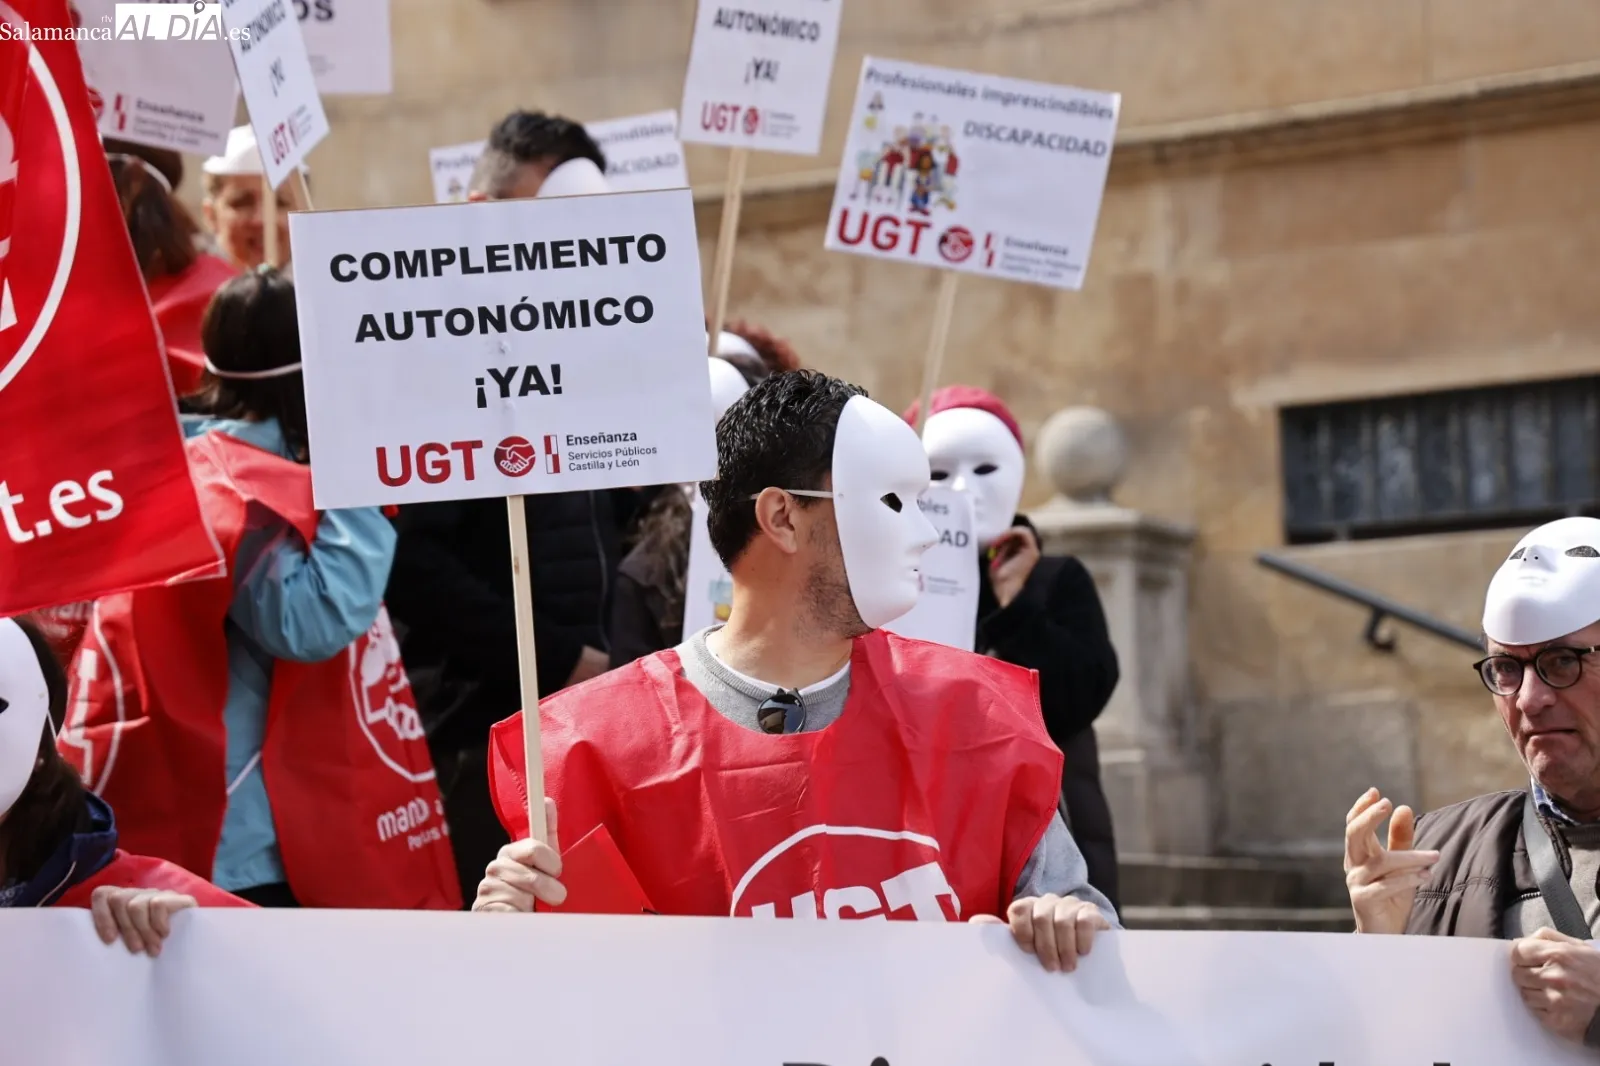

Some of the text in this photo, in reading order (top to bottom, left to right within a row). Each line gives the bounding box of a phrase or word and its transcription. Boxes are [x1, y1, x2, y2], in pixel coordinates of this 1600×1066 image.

[865, 67, 977, 99] Profesionales
[701, 100, 742, 134] UGT
[962, 119, 1109, 158] DISCAPACIDAD
[836, 207, 933, 256] UGT
[329, 233, 667, 283] COMPLEMENTO
[354, 295, 655, 343] AUTONÓMICO
[474, 363, 563, 409] ¡YA!
[566, 432, 638, 447] Enseñanza
[567, 446, 658, 461] Servicios Públicos
[375, 439, 484, 487] UGT
[568, 456, 640, 472] Castilla y León
